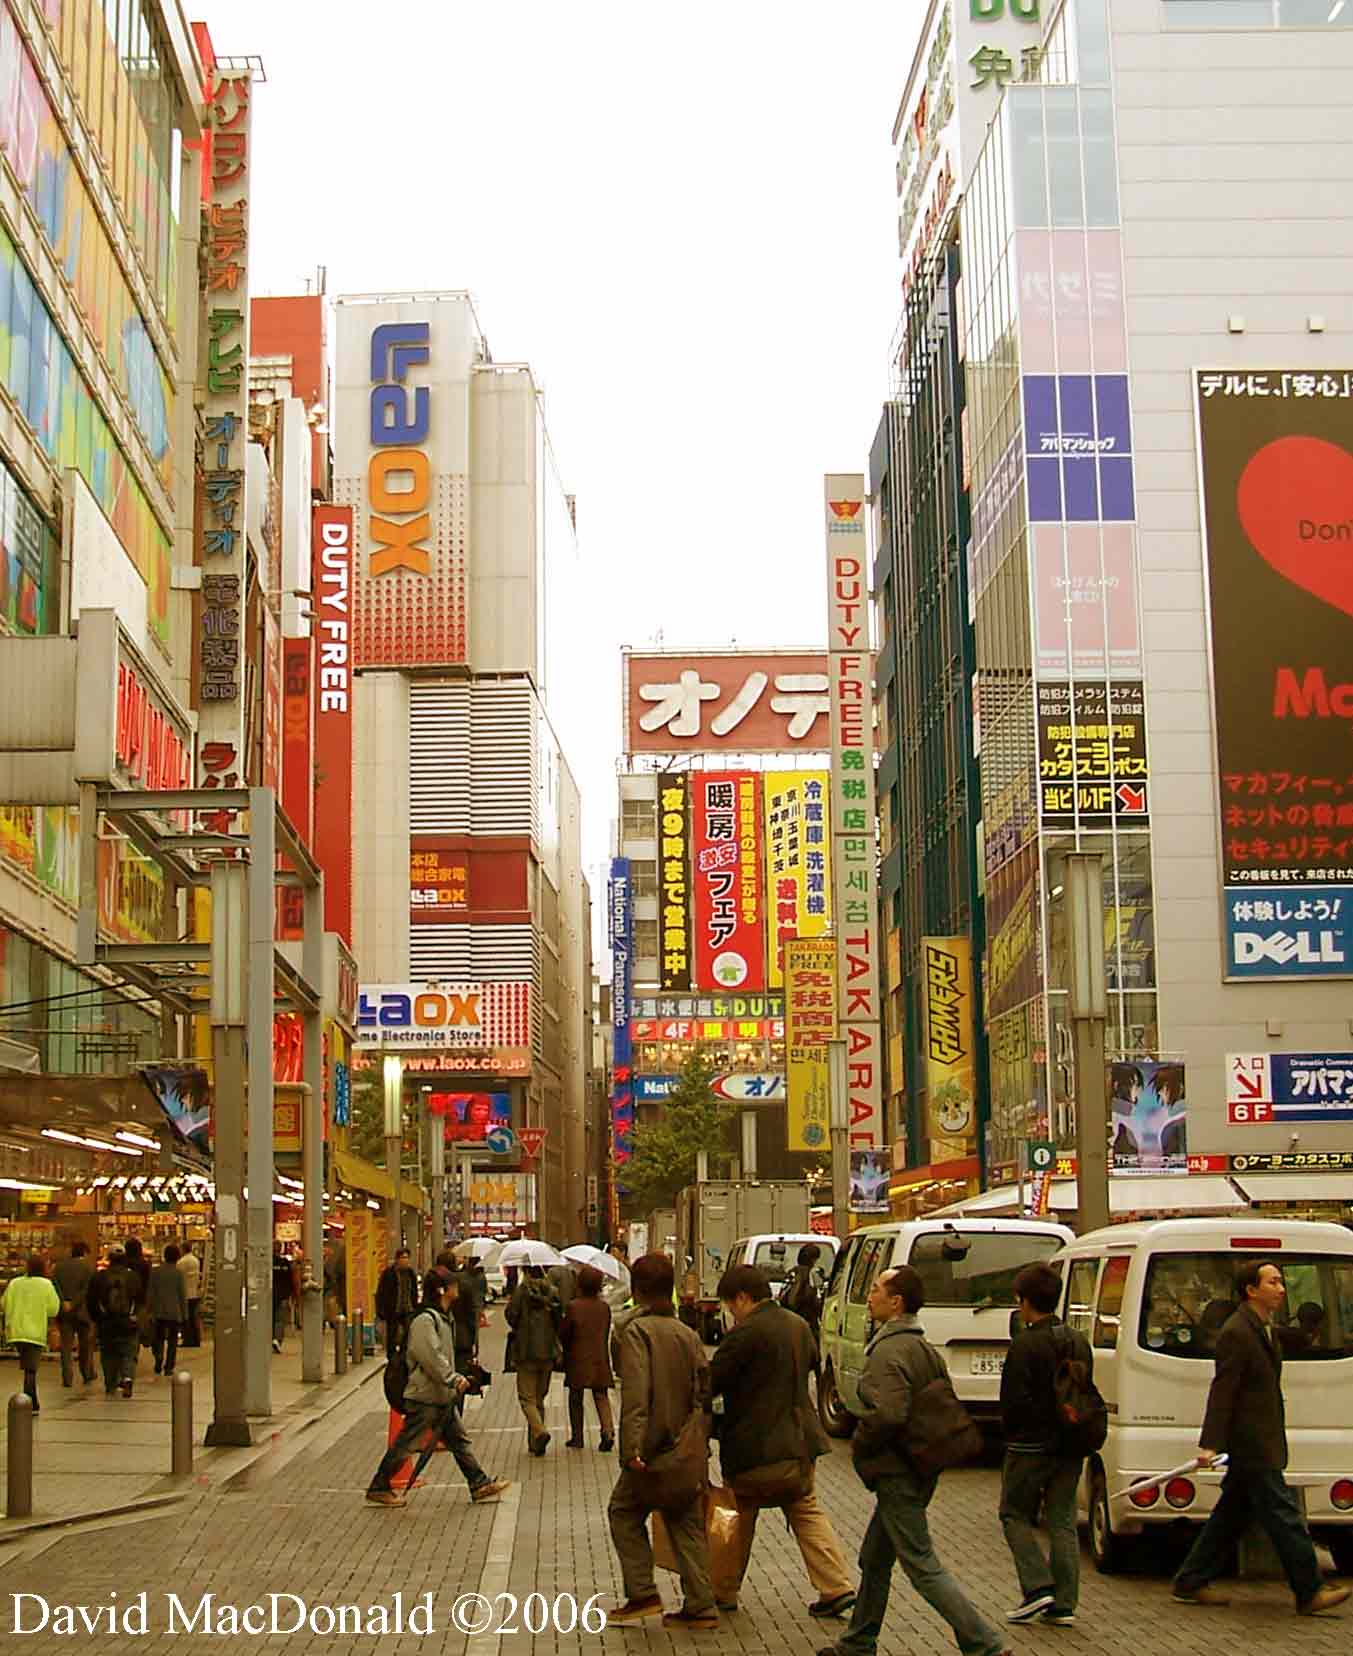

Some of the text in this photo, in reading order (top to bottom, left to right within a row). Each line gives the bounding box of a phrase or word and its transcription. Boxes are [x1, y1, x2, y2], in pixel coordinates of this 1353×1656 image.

[212, 76, 248, 190] パソコン
[207, 199, 247, 293] ビデオ
[207, 308, 245, 394] テレビ
[1200, 374, 1353, 397] デルに、「安心」
[204, 411, 244, 555] オーディオ
[1299, 519, 1353, 540] Don
[835, 558, 862, 647] DUTY
[320, 523, 349, 713] DUTY FREE
[839, 656, 864, 748] FREE
[1223, 770, 1353, 796] マカフィー、
[1229, 836, 1353, 861] セキュリティ
[1233, 930, 1344, 964] DELL
[926, 945, 967, 1066] GAMERS
[382, 1030, 446, 1042] Electronics
[450, 1030, 481, 1041] Store
[665, 1022, 690, 1039] 4F
[1233, 1057, 1264, 1070] 入口
[745, 1076, 786, 1097] オノ
[1234, 1104, 1268, 1121] 6F
